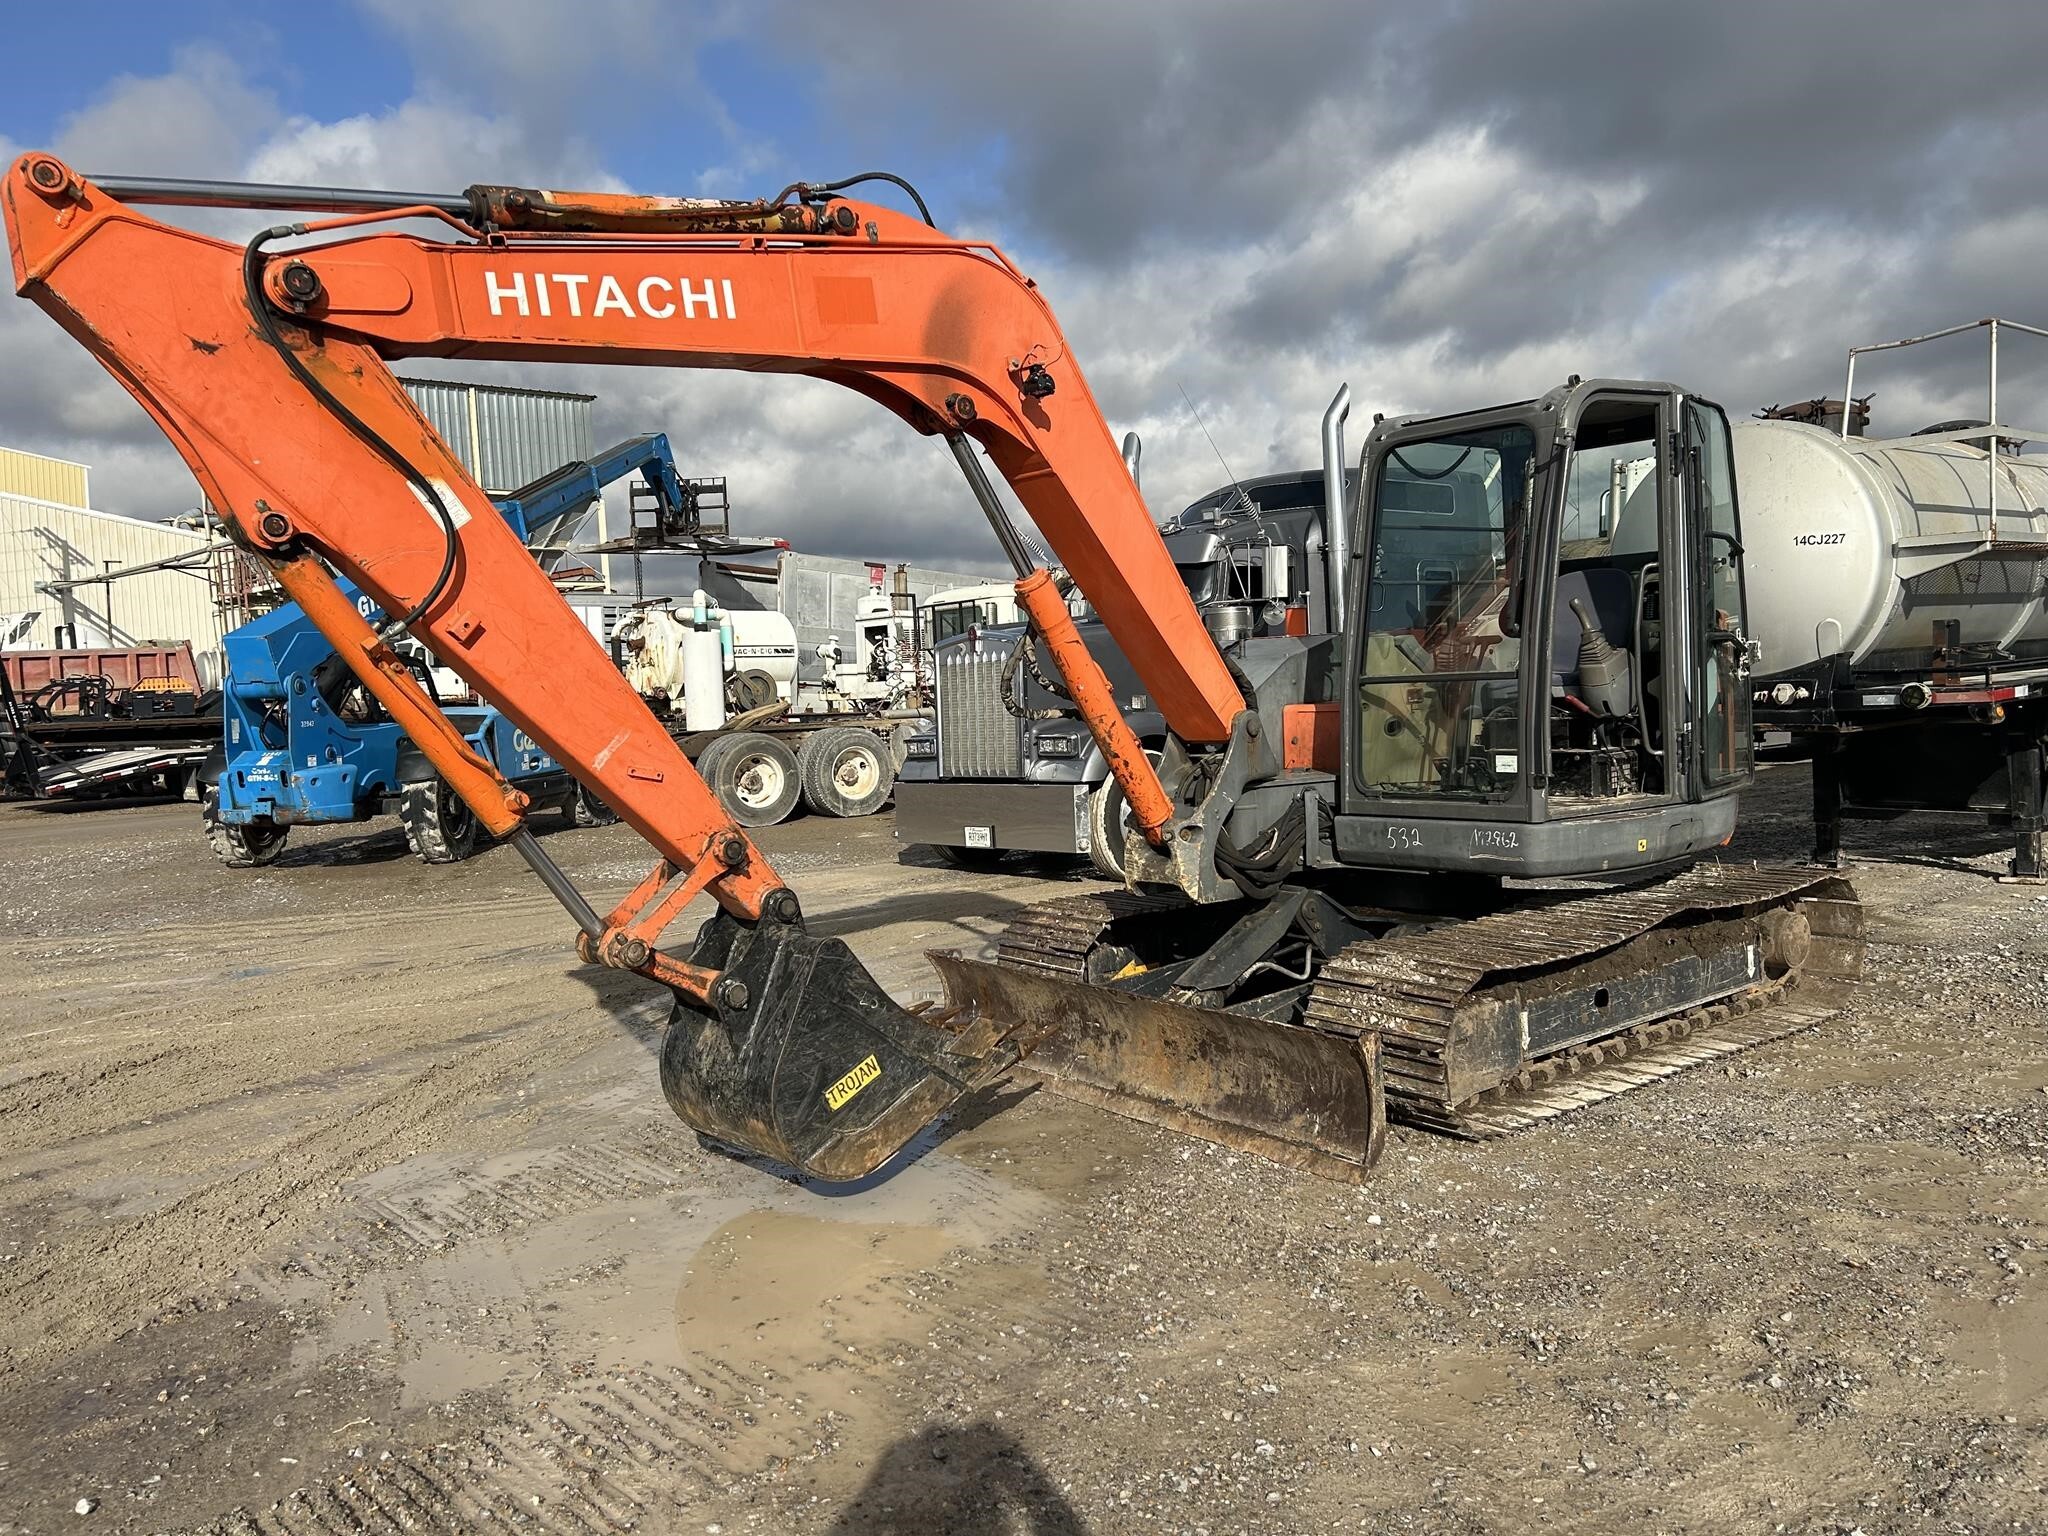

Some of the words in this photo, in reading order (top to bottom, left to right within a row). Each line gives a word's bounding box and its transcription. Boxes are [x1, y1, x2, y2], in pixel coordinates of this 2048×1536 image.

[484, 271, 737, 319] HITACHI
[1793, 533, 1846, 546] 14CJ227
[357, 595, 381, 618] GT
[1387, 826, 1424, 849] 532
[827, 1058, 878, 1103] TROJAN
